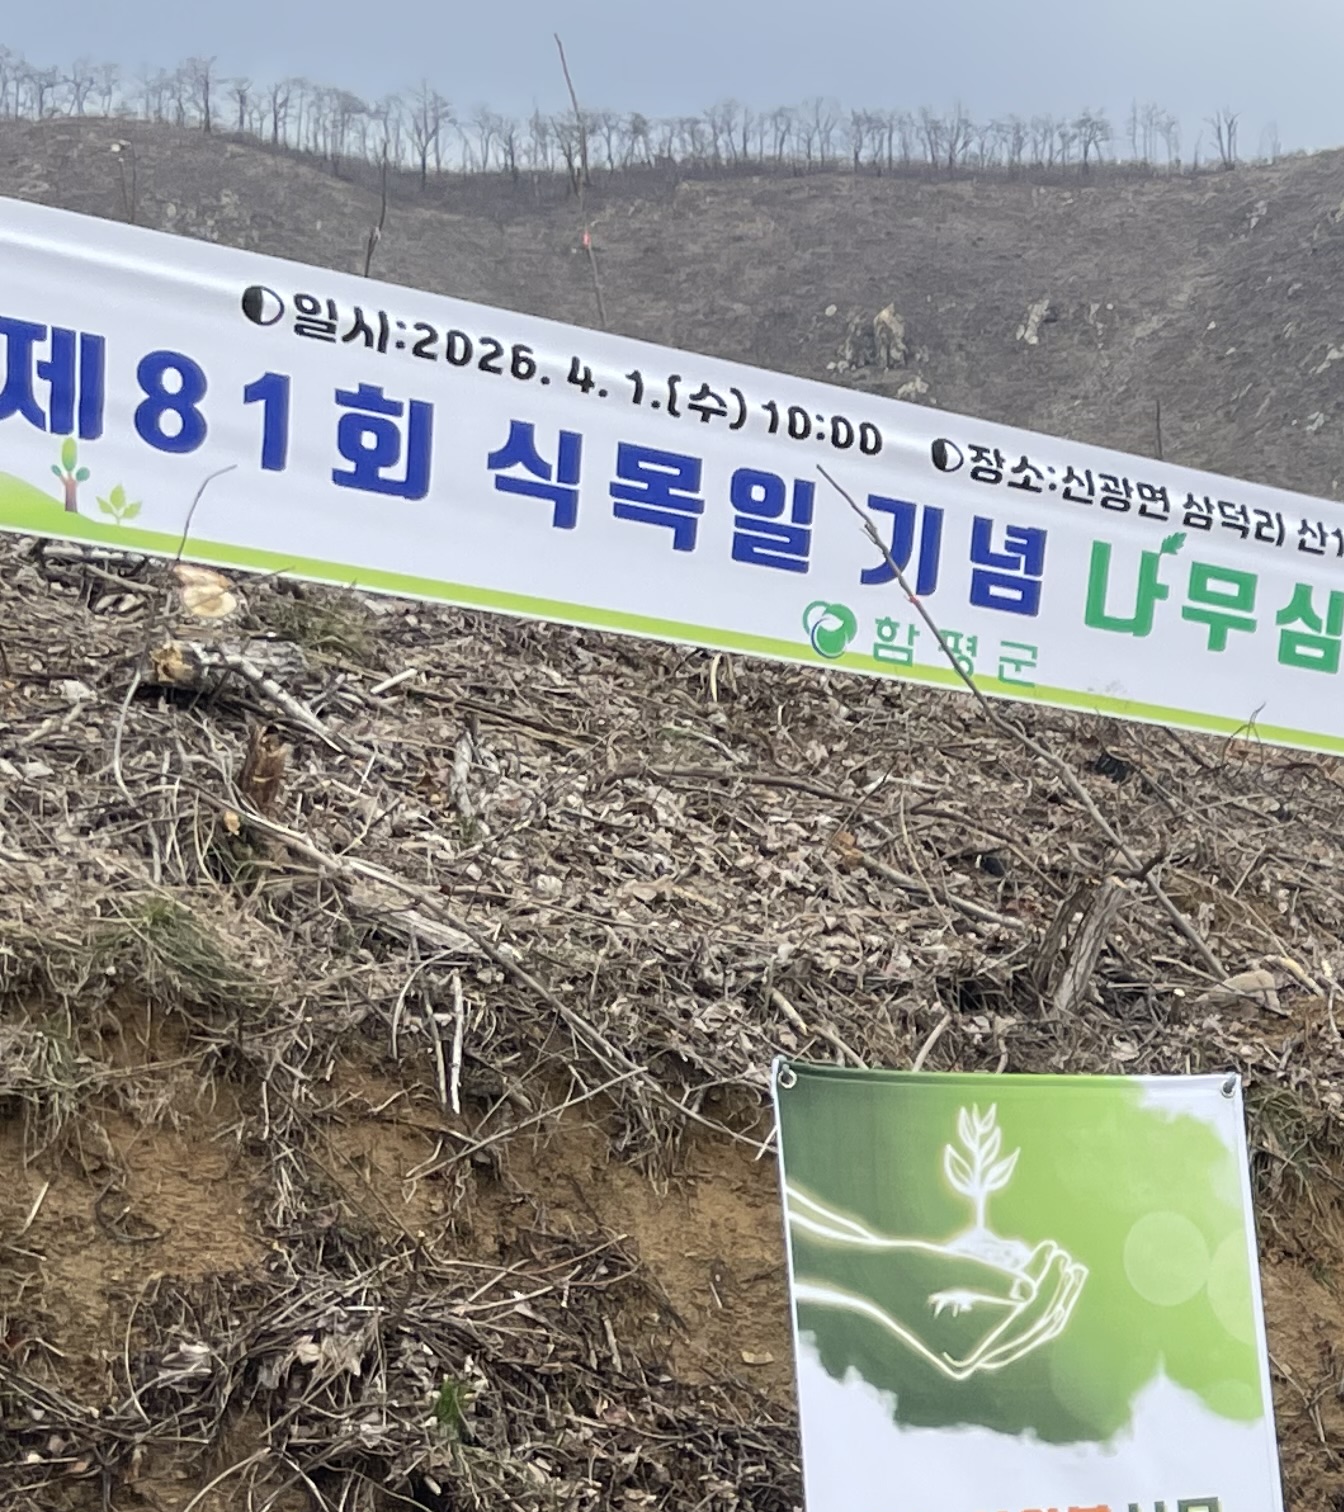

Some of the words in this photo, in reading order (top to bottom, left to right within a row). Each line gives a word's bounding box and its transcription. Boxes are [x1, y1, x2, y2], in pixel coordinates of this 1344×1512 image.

[762, 401, 882, 455] 10:00
[0, 317, 434, 500] 제81회
[487, 418, 815, 573] 식목일
[860, 494, 1047, 616] 기념
[1183, 493, 1284, 547] 삼덕리
[871, 616, 1039, 687] 함평군
